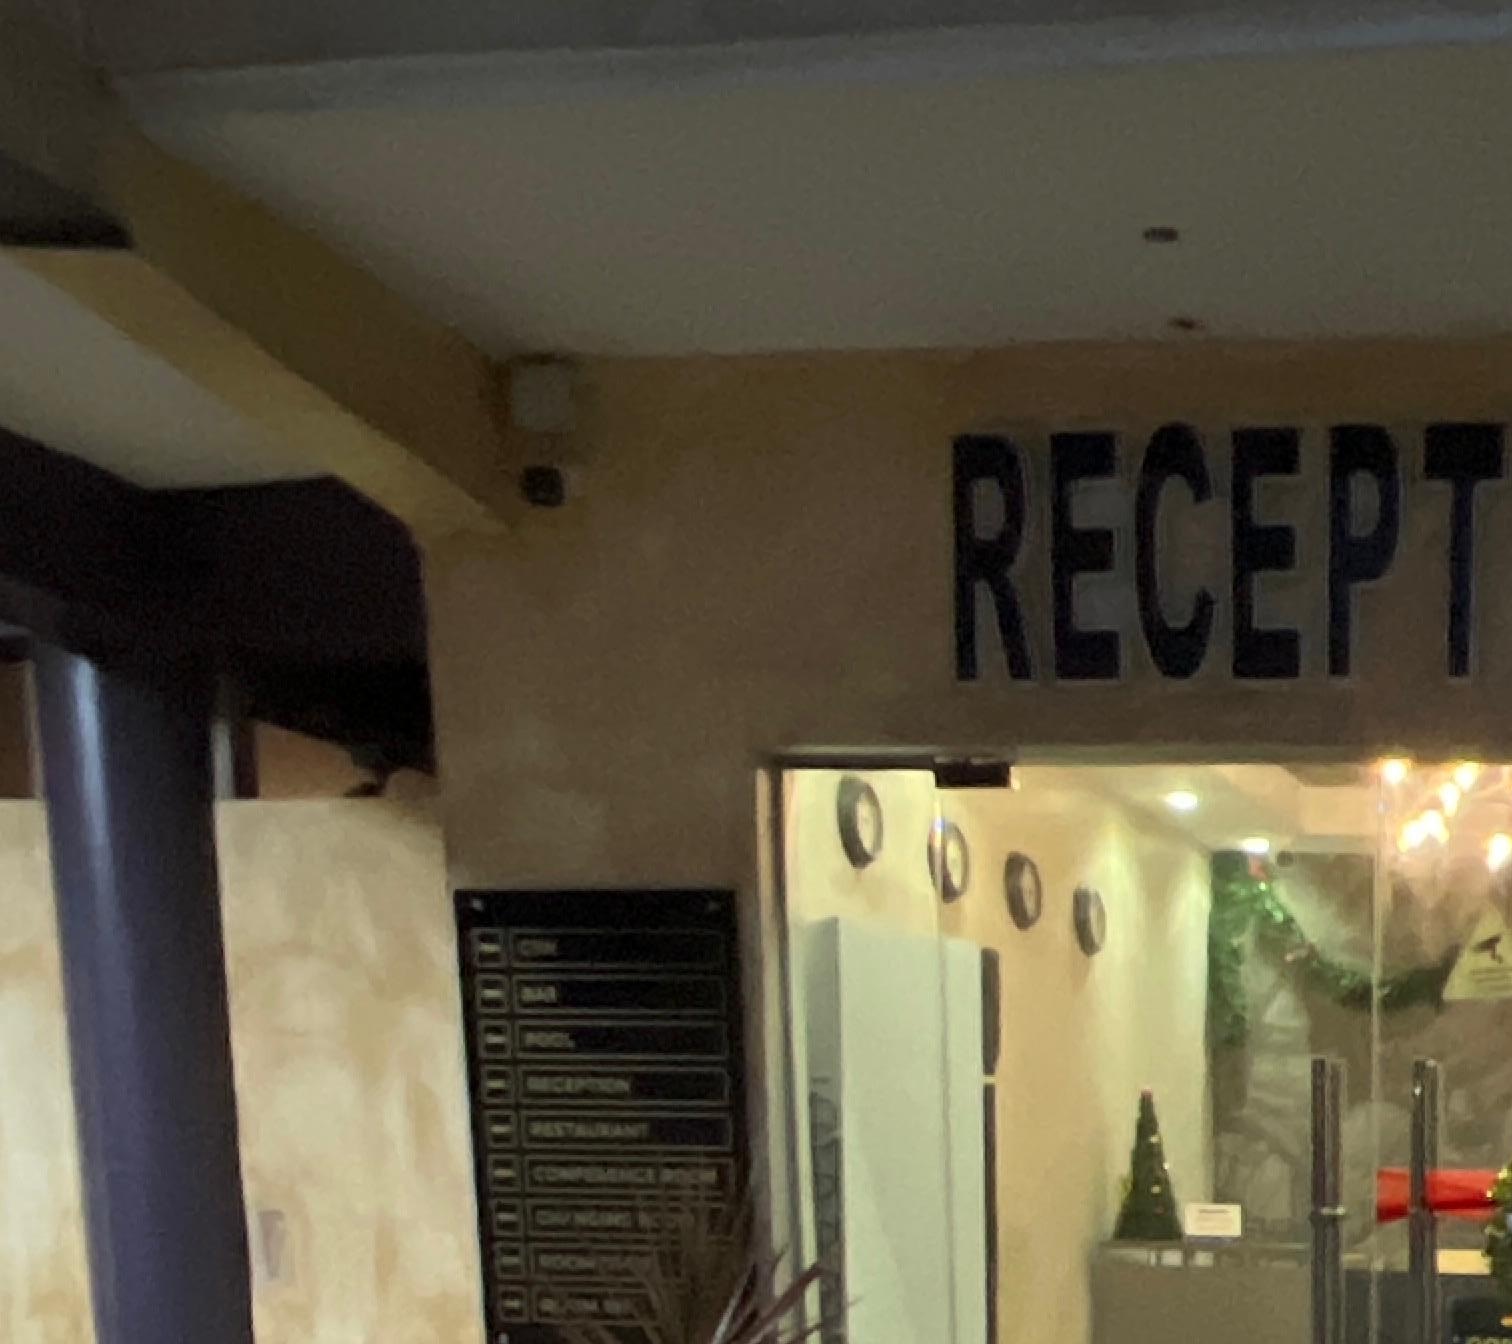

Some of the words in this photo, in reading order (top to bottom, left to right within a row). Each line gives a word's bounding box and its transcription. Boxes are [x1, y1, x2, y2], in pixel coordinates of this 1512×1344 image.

[520, 985, 557, 1004] BAR
[526, 1075, 631, 1094] RECEPTION
[528, 1120, 650, 1138] RESTAURANT
[532, 1165, 656, 1184] CONFERENCE
